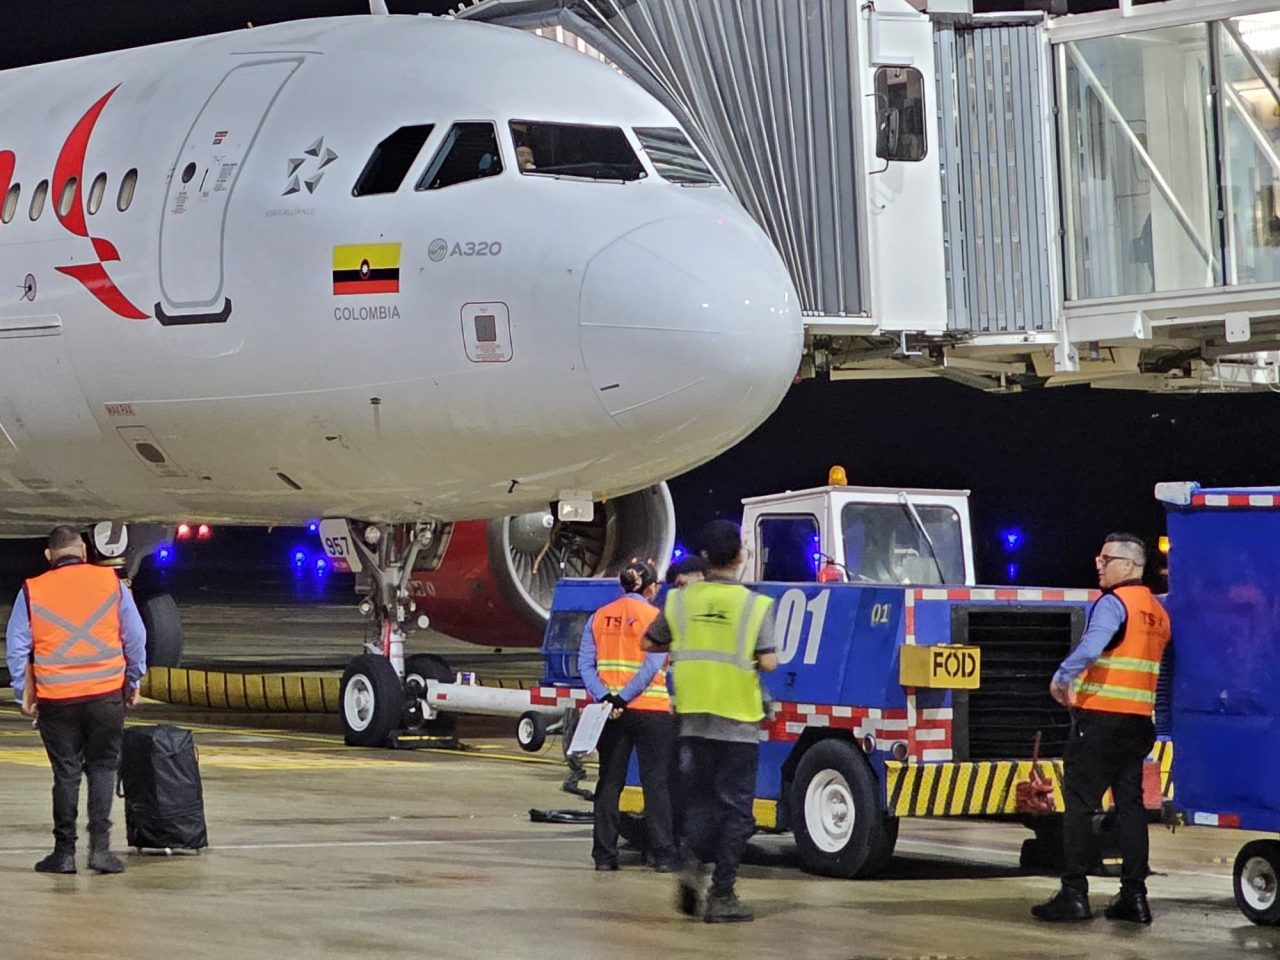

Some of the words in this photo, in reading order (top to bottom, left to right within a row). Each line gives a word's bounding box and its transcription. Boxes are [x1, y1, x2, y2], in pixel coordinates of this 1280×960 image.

[449, 241, 502, 257] A320
[333, 306, 401, 321] COLOMBIA
[325, 536, 350, 556] 957
[871, 603, 891, 625] 01
[774, 588, 831, 665] 01
[933, 652, 977, 679] FOD
